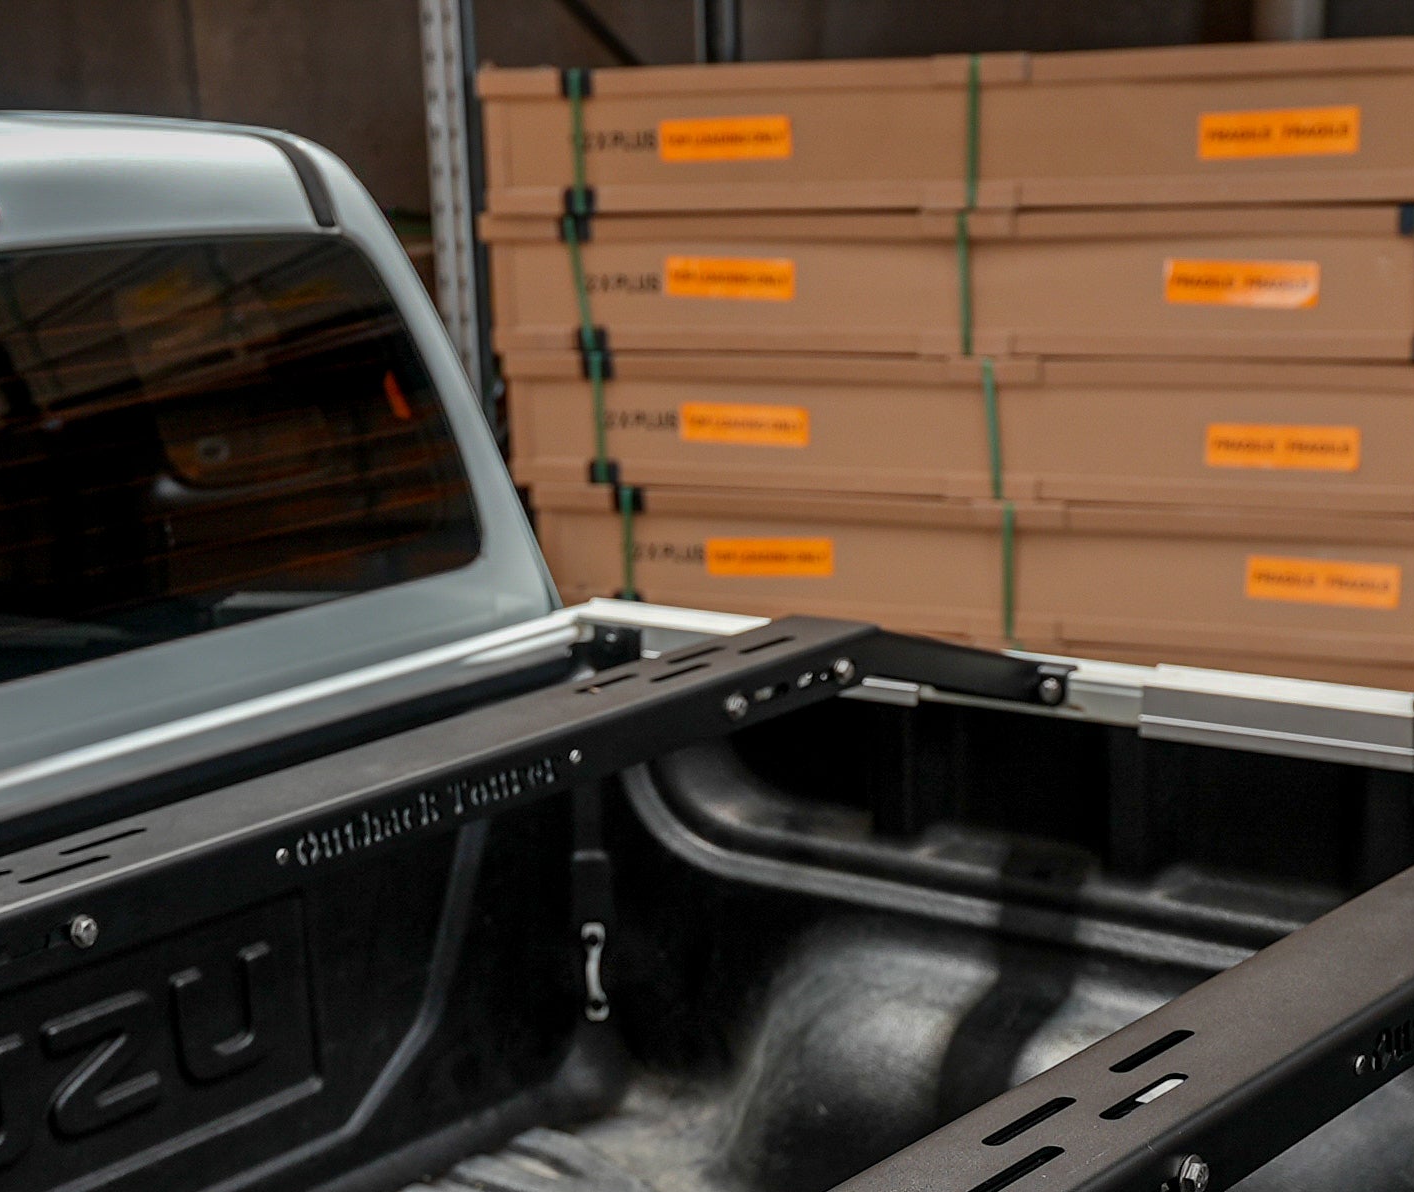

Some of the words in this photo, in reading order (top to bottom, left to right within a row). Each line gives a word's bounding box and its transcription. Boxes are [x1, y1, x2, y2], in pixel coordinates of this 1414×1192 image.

[1206, 124, 1272, 143] FRAGILE
[1281, 121, 1350, 140] FRAGILE
[1169, 272, 1234, 291] FRAGILE
[1242, 274, 1309, 293] FRAGILE
[1211, 437, 1276, 455] FRAGILE
[1284, 439, 1350, 458] FRAGILE
[1251, 570, 1316, 589] FRAGILE
[1325, 573, 1390, 595] FRAGILE
[295, 790, 442, 867] Outback
[446, 756, 557, 815] Tourer
